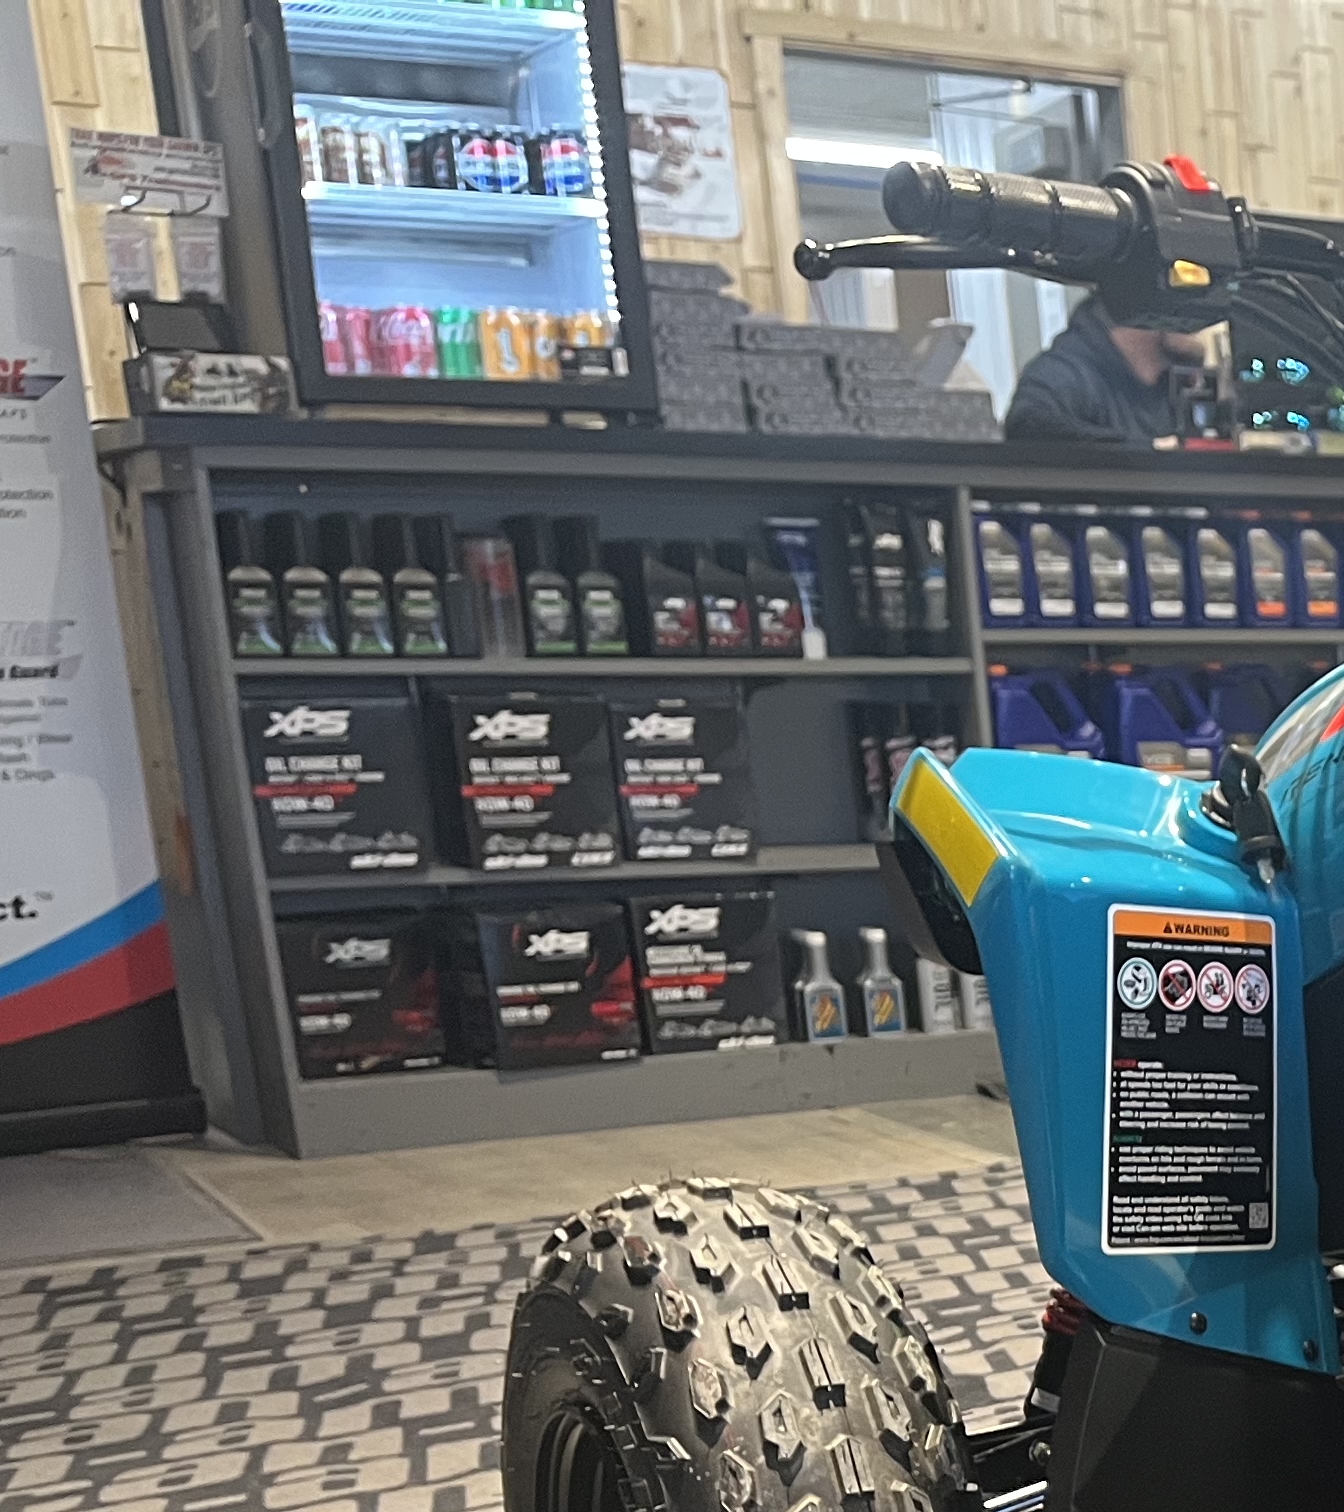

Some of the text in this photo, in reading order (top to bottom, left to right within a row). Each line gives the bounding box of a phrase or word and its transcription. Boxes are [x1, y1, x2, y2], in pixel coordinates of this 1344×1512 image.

[264, 706, 352, 738] XPS
[469, 710, 551, 741] XPS
[623, 713, 697, 741] XPS
[644, 904, 721, 935] XPS
[1174, 923, 1230, 937] WARNING
[524, 929, 590, 957] XPS
